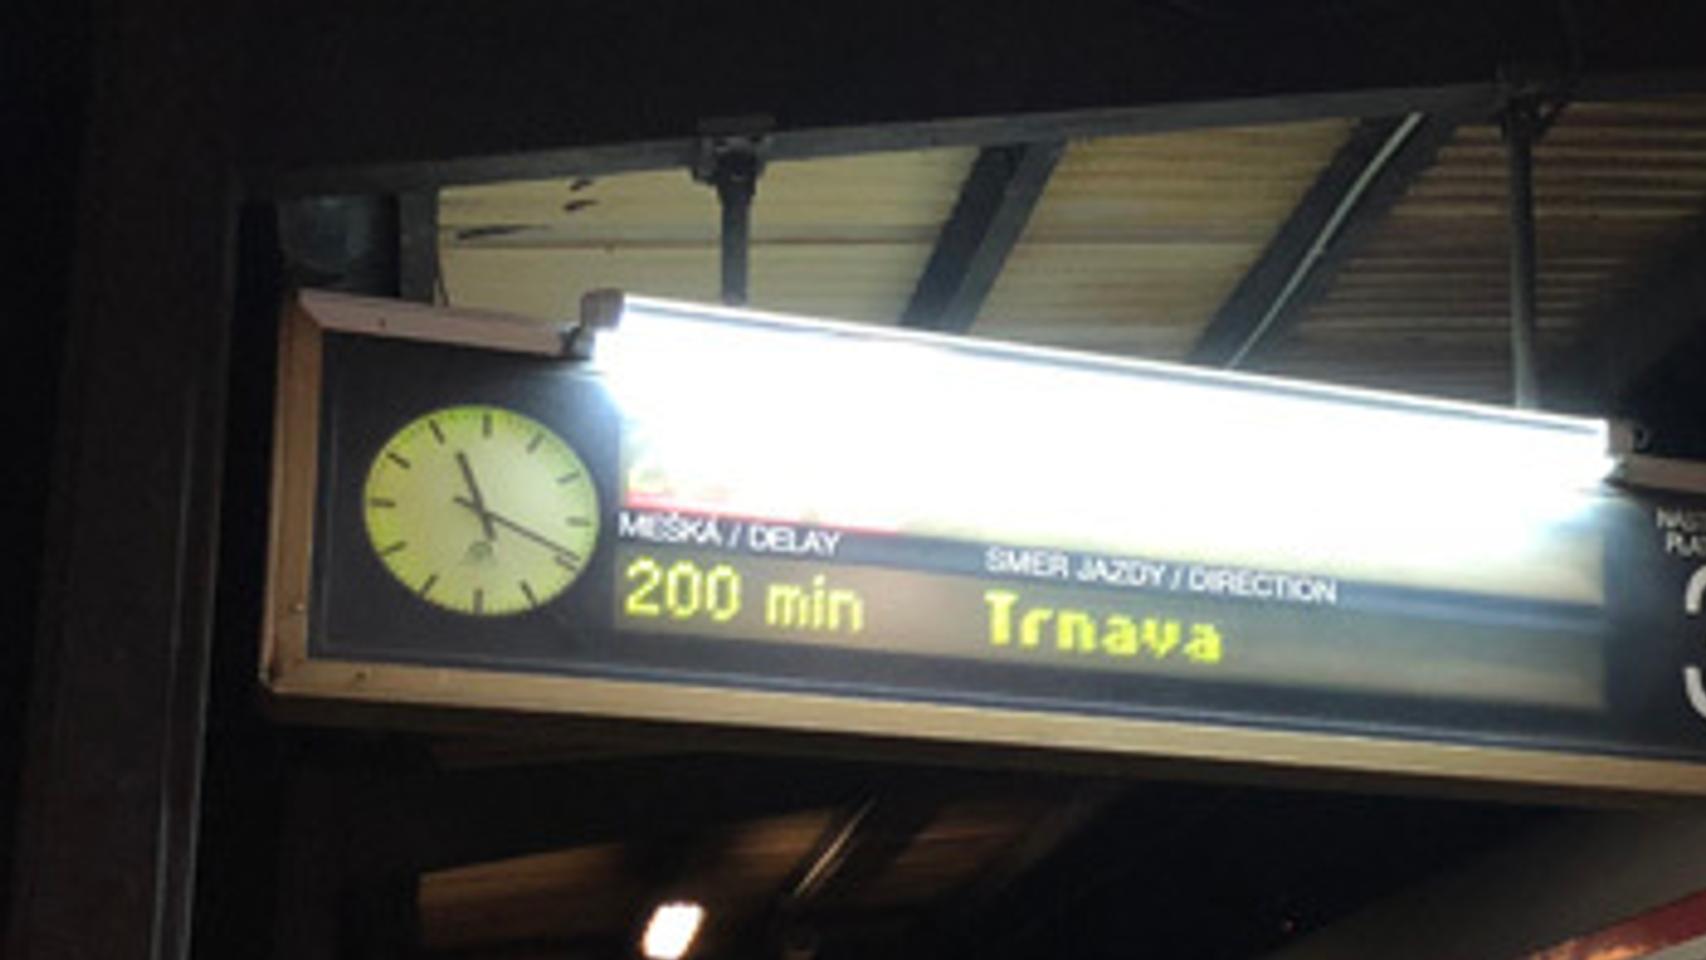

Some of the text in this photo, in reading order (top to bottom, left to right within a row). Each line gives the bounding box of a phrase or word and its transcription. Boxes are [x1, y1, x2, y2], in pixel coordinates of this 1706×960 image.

[748, 527, 841, 557] DELAY
[985, 545, 1069, 579] SMER
[1076, 559, 1166, 590] JAZDY
[1188, 567, 1337, 603] DIRECTION
[623, 557, 864, 633] 200 min
[983, 590, 1226, 665] Trnava
